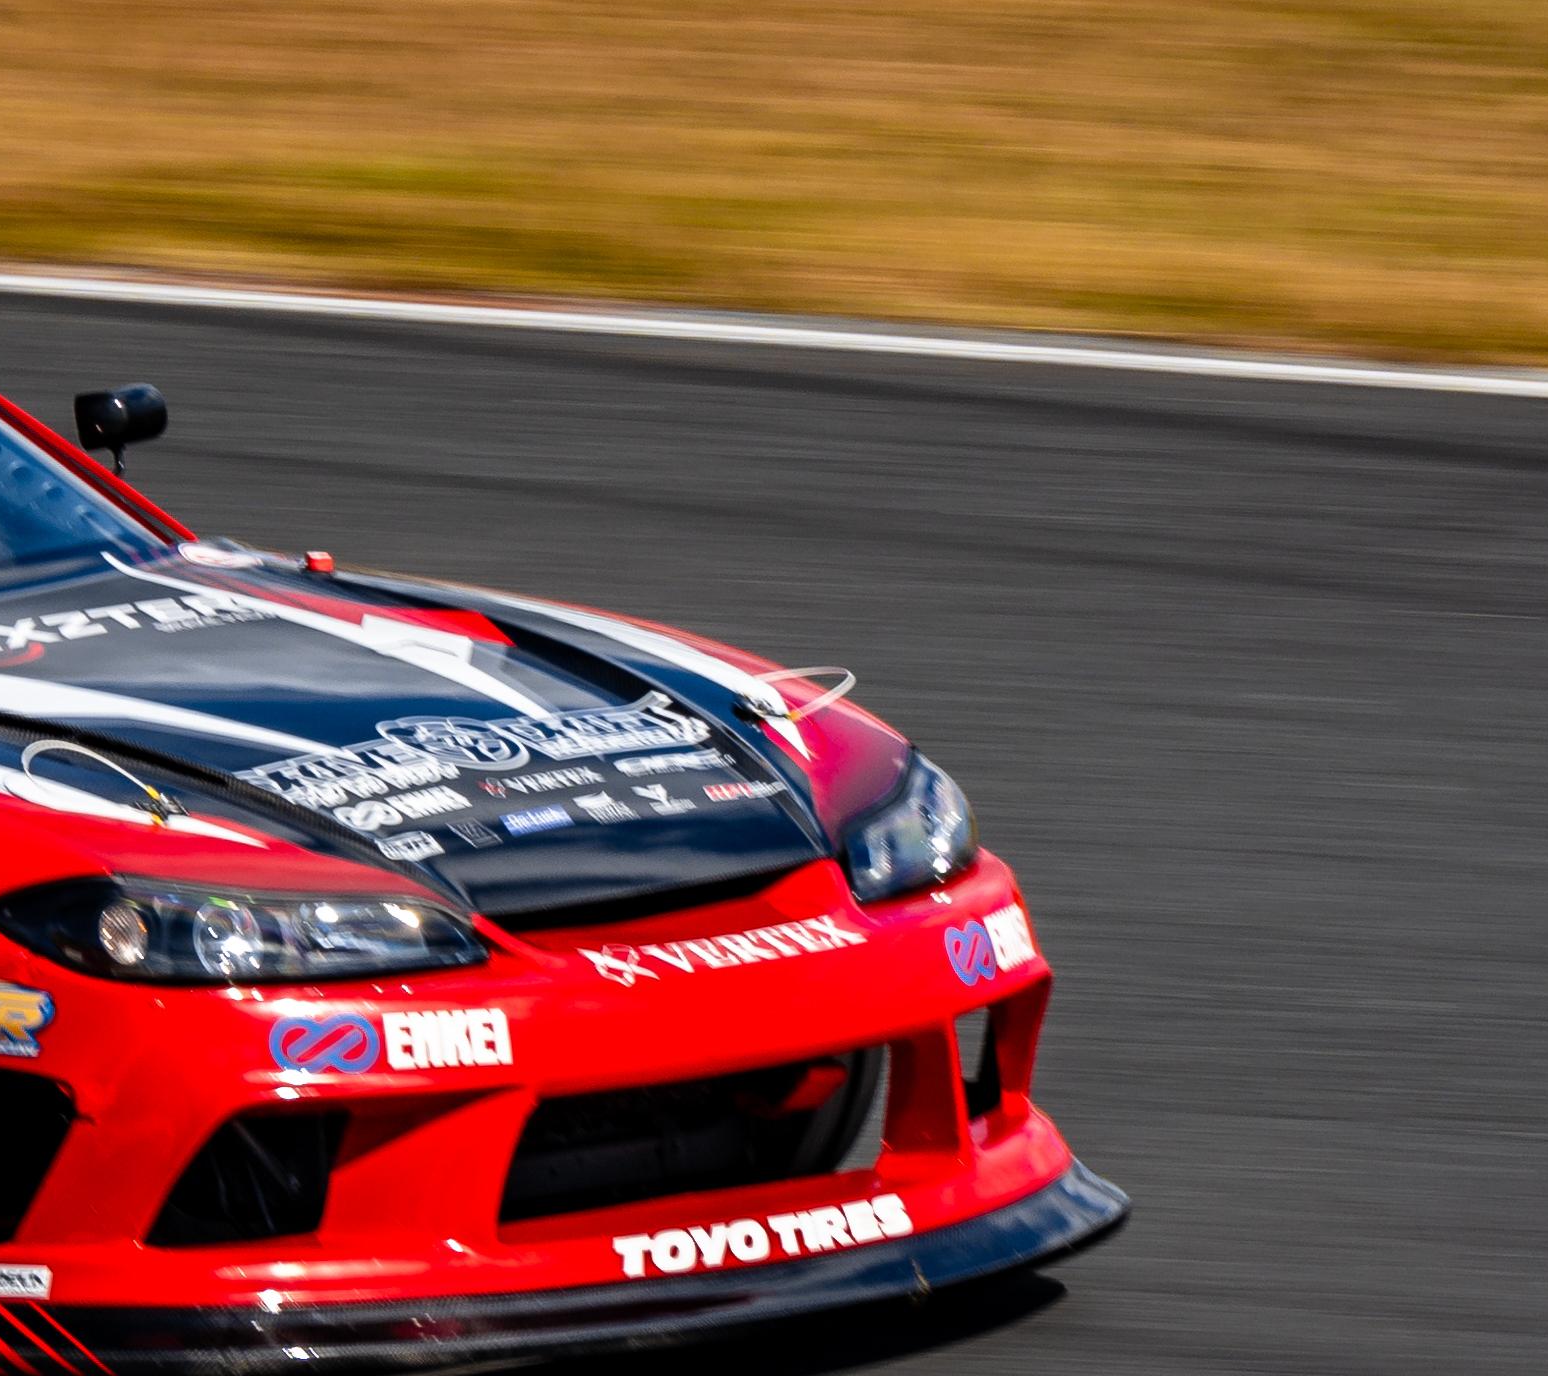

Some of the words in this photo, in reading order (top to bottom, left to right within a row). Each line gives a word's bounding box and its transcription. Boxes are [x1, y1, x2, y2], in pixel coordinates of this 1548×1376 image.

[638, 914, 868, 974] VERTEX
[382, 1008, 514, 1070] ENKEI
[613, 1215, 771, 1279] TOYO
[765, 1193, 914, 1255] TIRES
